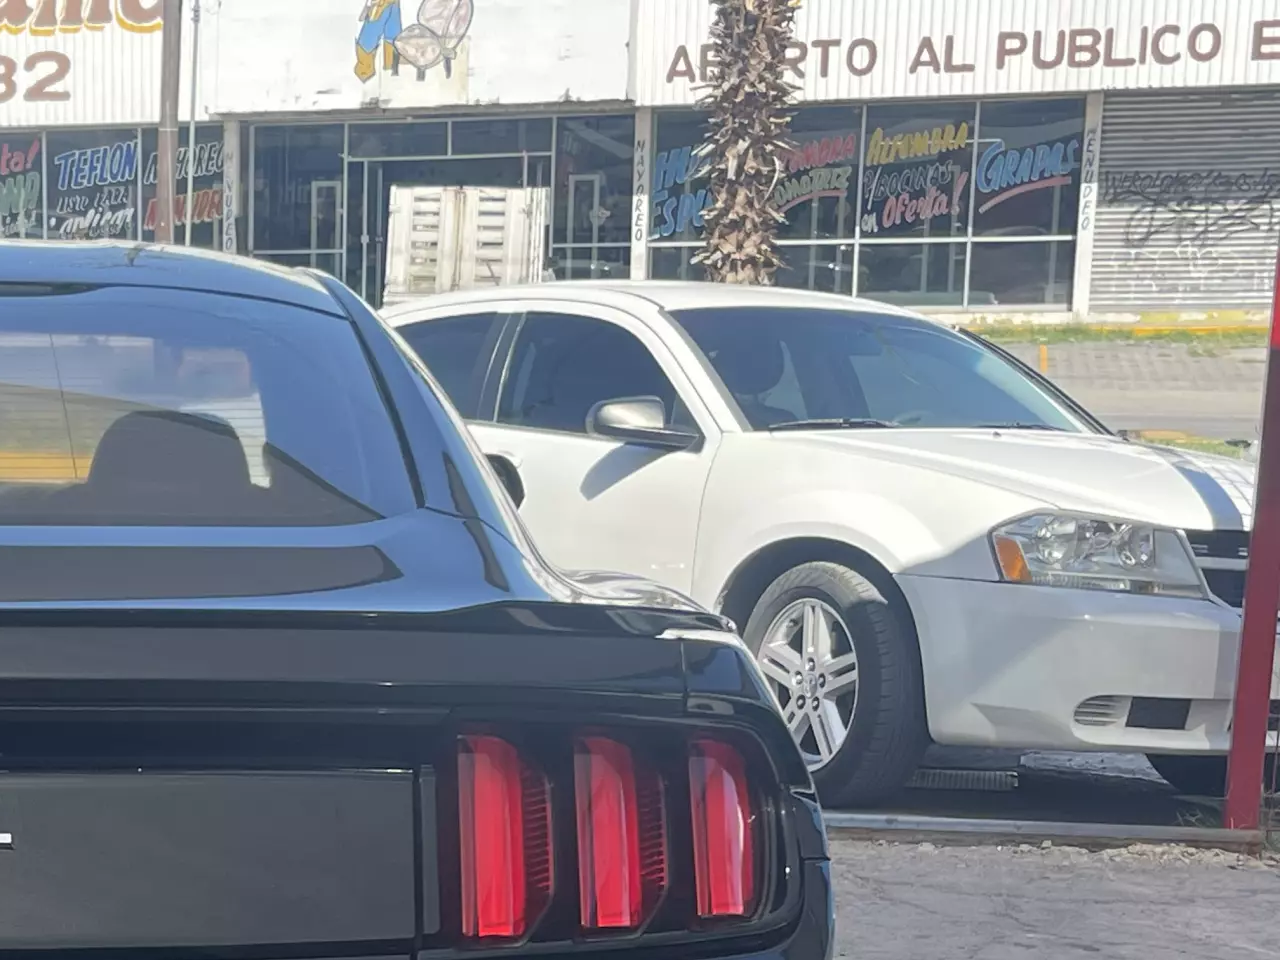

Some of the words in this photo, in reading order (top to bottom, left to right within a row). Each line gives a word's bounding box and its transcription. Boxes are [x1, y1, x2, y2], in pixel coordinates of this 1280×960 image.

[909, 35, 976, 75] AL
[995, 22, 1222, 70] PUBLICO
[54, 139, 138, 191] TEFLON
